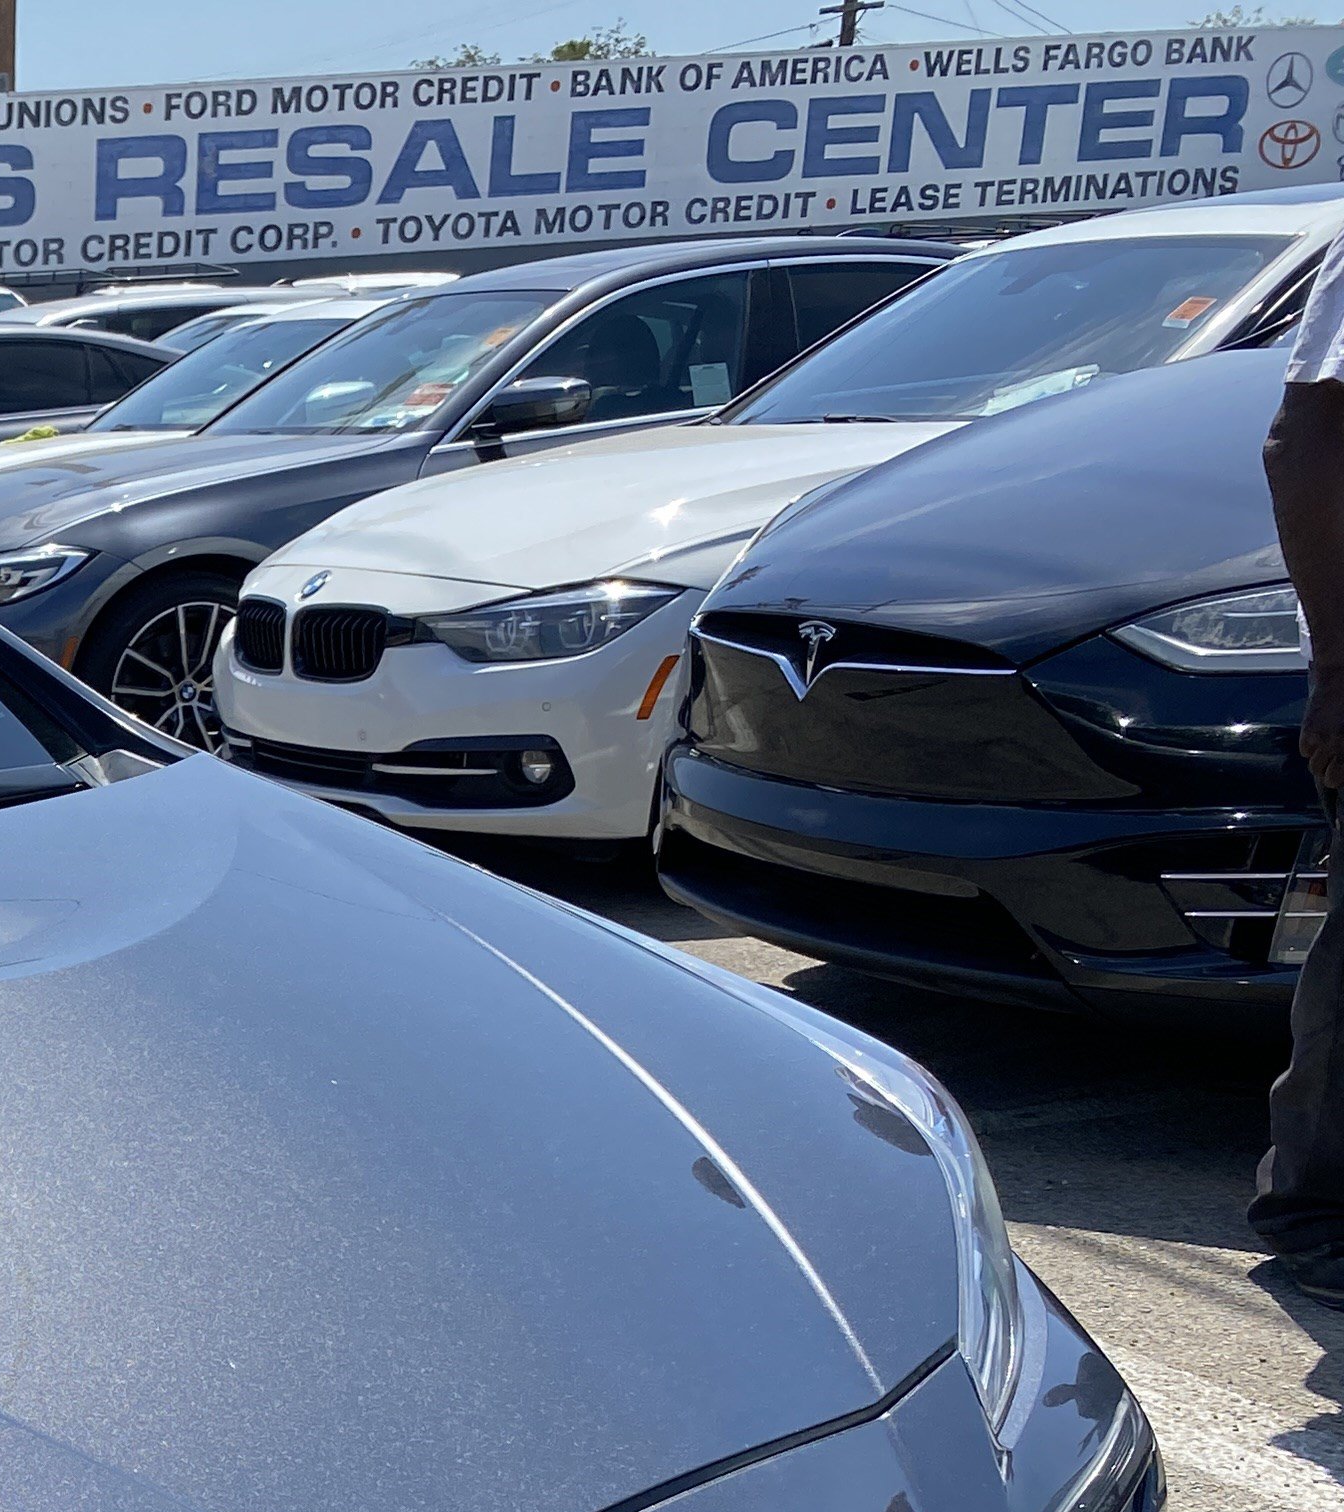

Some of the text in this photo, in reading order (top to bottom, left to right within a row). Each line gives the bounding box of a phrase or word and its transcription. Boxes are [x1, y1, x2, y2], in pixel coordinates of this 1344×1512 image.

[163, 89, 258, 122] FORD
[270, 82, 399, 116] MOTOR
[412, 72, 541, 107] CREDIT
[569, 64, 665, 98] BANK
[679, 61, 724, 93] OF
[730, 53, 890, 90] AMERICA
[923, 44, 1030, 78] WELLS
[1041, 37, 1153, 72] FARGO
[1164, 34, 1257, 65] BANK
[94, 107, 652, 222] RESALE
[706, 73, 1251, 185] CENTER
[81, 228, 213, 265] CREDIT
[229, 220, 339, 256] CORP.
[376, 209, 521, 245] TOYOTA
[533, 200, 671, 236] MOTOR
[683, 191, 817, 224] CREDIT
[849, 182, 963, 216] LEASE
[974, 165, 1240, 208] TERMINATIONS
